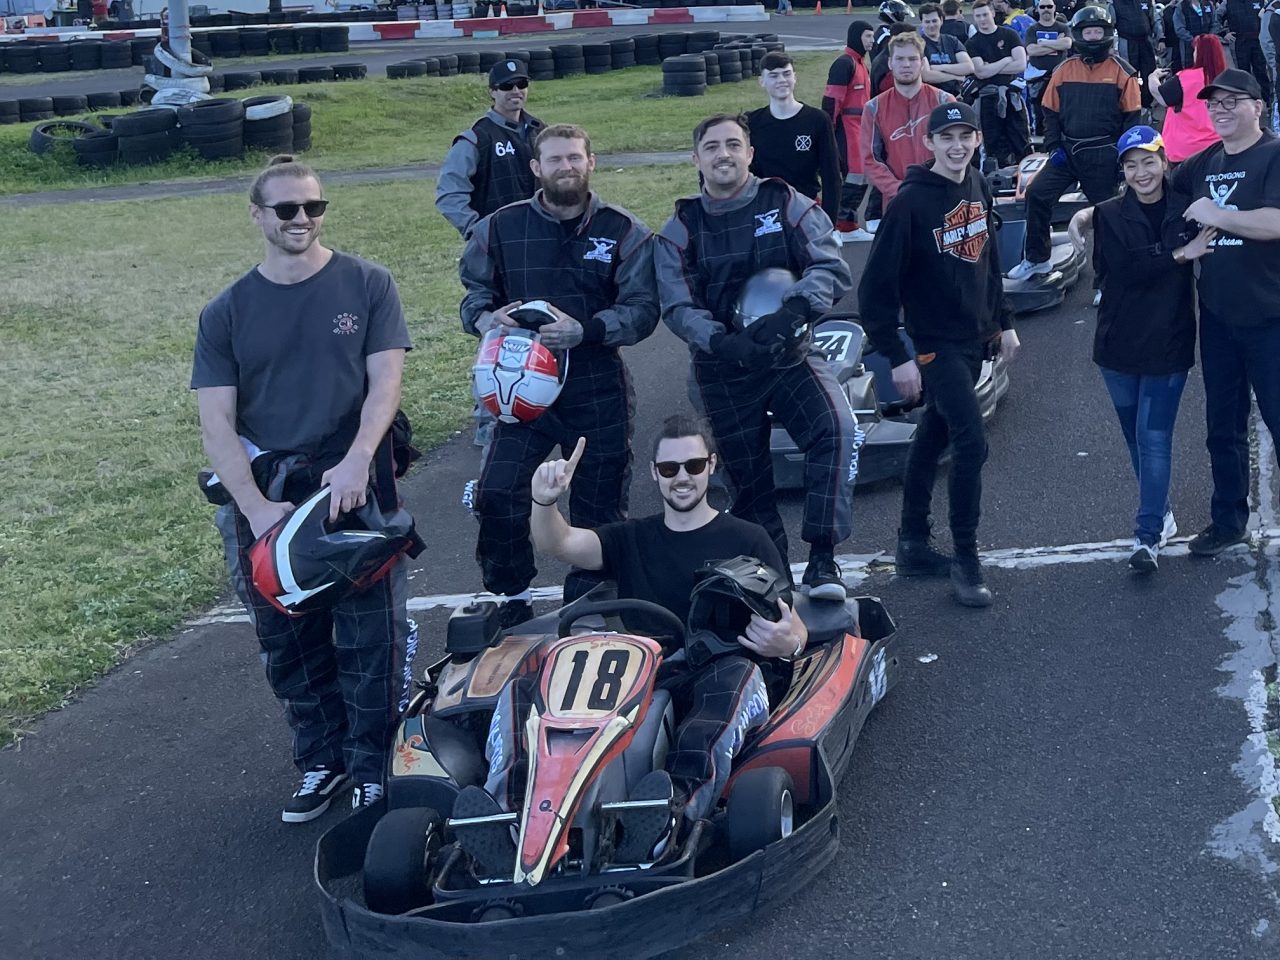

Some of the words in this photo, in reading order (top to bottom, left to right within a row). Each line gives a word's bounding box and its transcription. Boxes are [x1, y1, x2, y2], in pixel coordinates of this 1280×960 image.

[495, 140, 515, 157] 64
[1217, 235, 1244, 246] dream
[559, 649, 631, 711] 18
